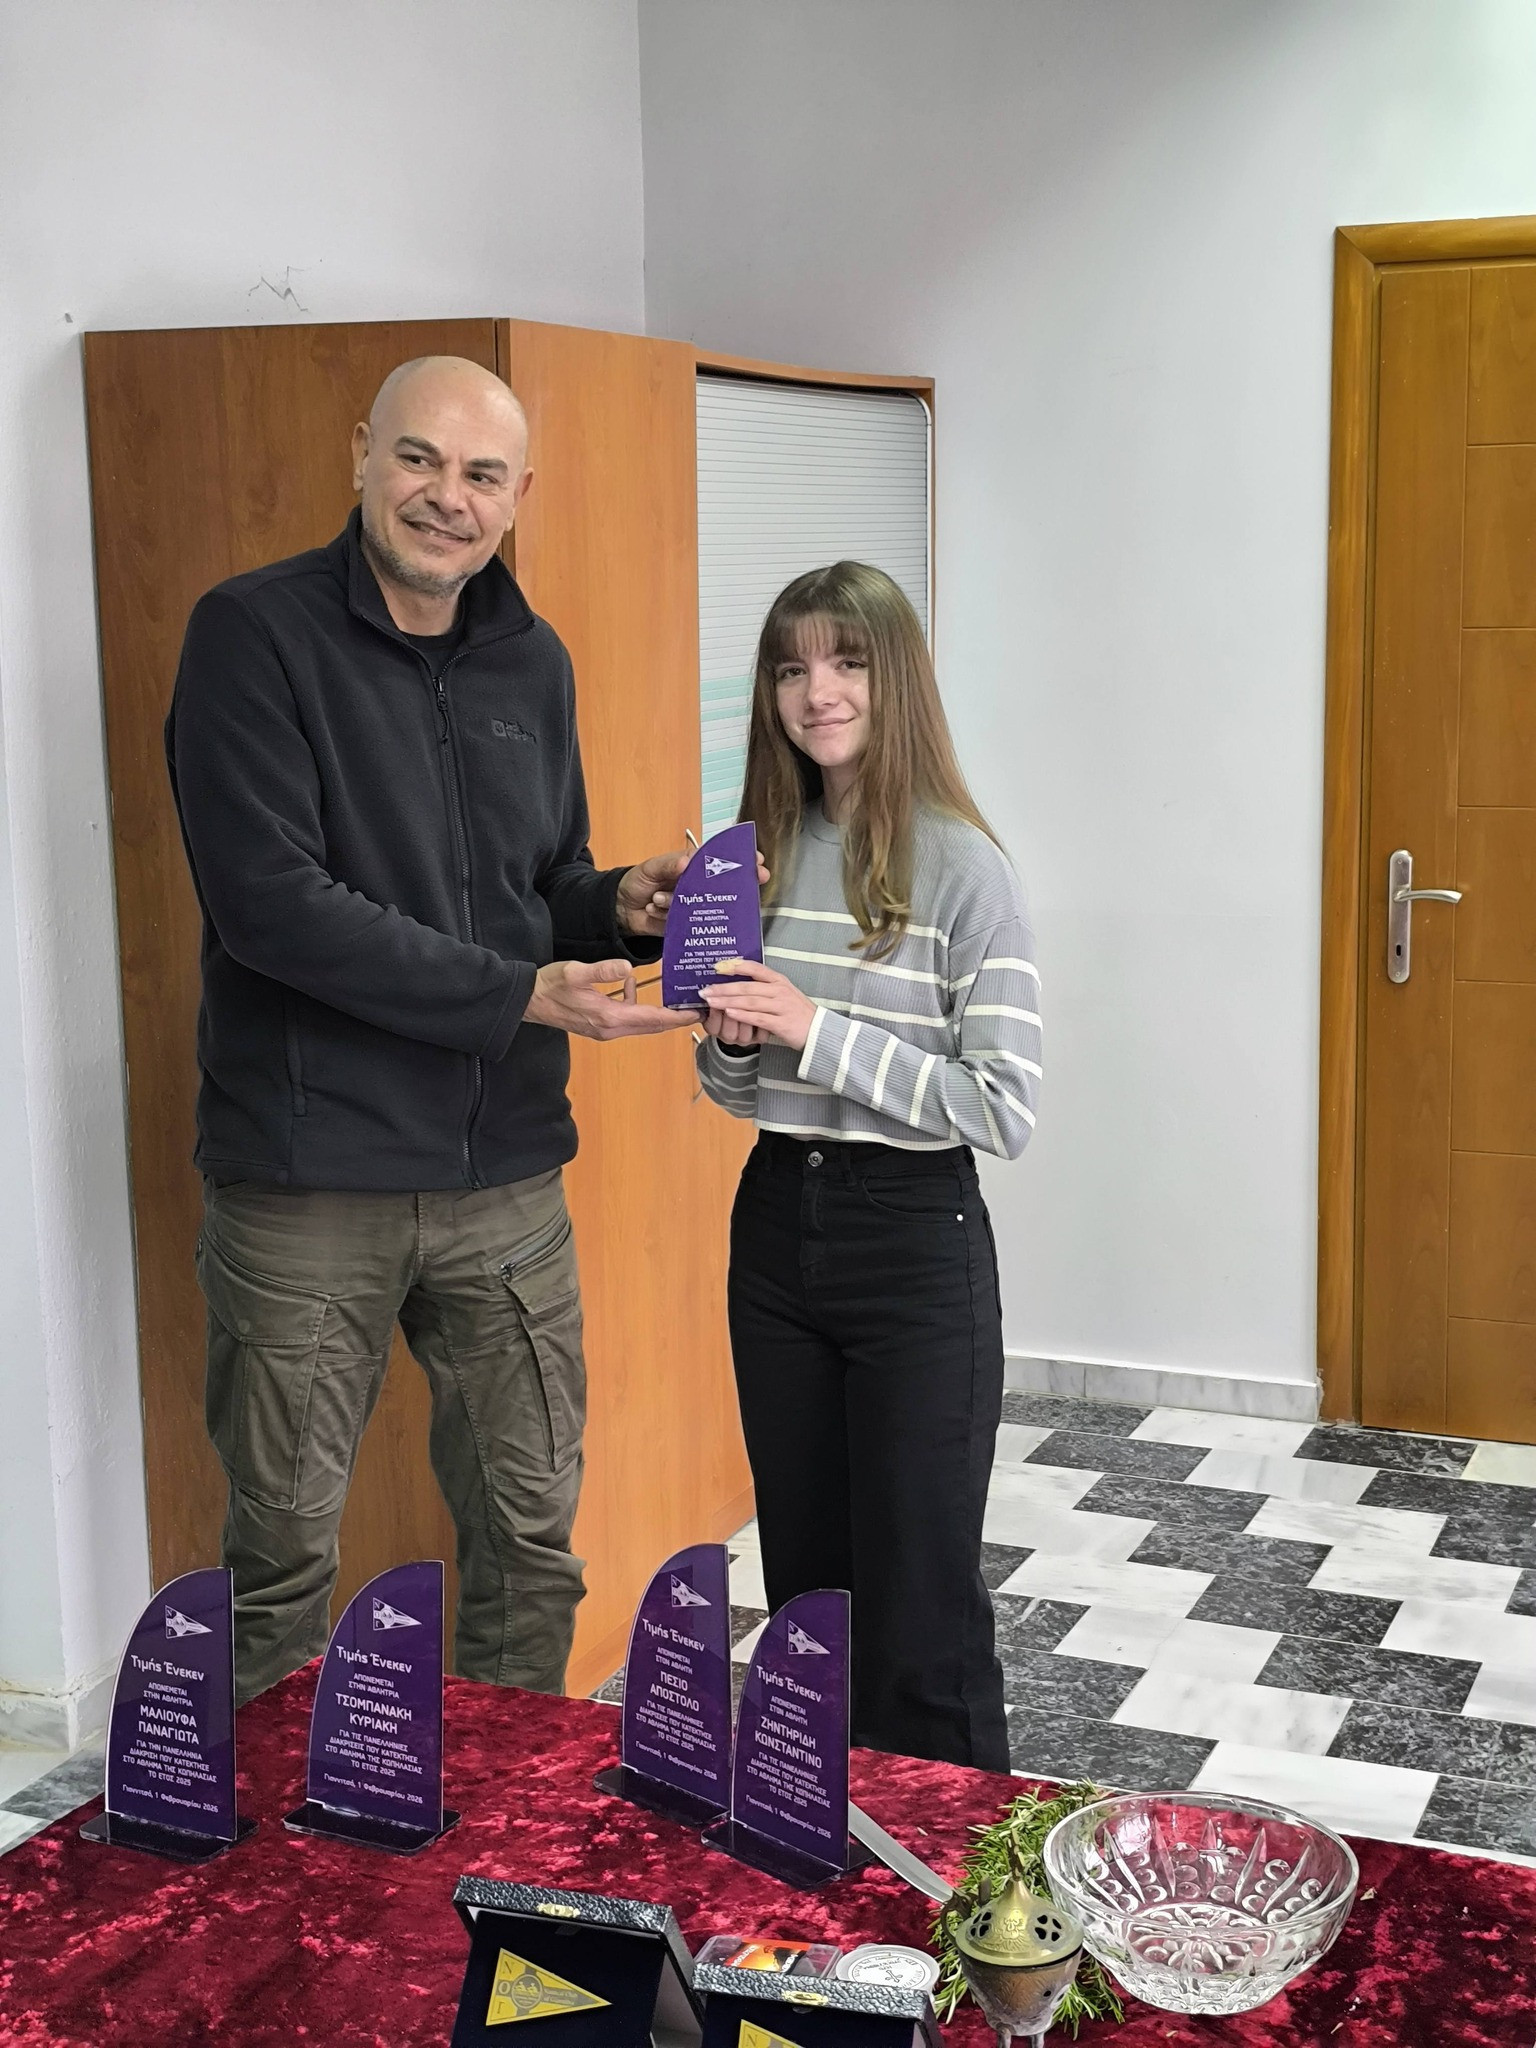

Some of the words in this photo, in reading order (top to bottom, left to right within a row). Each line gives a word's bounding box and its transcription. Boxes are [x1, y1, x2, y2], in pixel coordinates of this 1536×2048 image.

[678, 894, 703, 905] Τιμής
[705, 894, 737, 902] Ένεκεν
[692, 926, 728, 935] ΠΑΛΑΝΗ
[684, 937, 736, 947] ΑΙΚΑΤΕΡΙΝΗ
[642, 1618, 669, 1639] Τιμής
[670, 1628, 704, 1652] Ένεκεν
[131, 1655, 161, 1673] Τιμής
[164, 1661, 204, 1681] Ένεκεν
[336, 1645, 368, 1664] Τιμής
[370, 1653, 412, 1674] Ένεκεν
[348, 1681, 366, 1691] ΣΤΗΝ
[660, 1671, 688, 1692] ΠΕΣΙΟ
[756, 1665, 784, 1687] Τιμής
[785, 1677, 822, 1702] Ένεκεν
[143, 1690, 160, 1700] ΣΤΗΝ
[647, 1700, 656, 1709] ΓΙΑ
[650, 1683, 699, 1712] ΑΠΟΣΤΟΛΟ
[140, 1704, 197, 1728] ΜΑΛΙΟΥΦΑ
[335, 1693, 412, 1721] ΤΣΟΜΠΑΝΑΚΗ
[139, 1721, 199, 1745] ΠΑΝΑΓΙΩΤΑ
[350, 1713, 397, 1734] ΚΥΡΙΑΚΗ
[761, 1716, 816, 1749] ΖΗΝΤΗΡΙΔΗ
[340, 1729, 350, 1738] ΓΙΑ
[352, 1732, 362, 1741] ΤΙΣ
[136, 1740, 147, 1748] ΓΙΑ
[148, 1742, 160, 1751] ΤΗΝ
[163, 1744, 202, 1760] ΠΑΝΕΛΛΗΝΙΑ
[325, 1744, 338, 1754] ΣΤΟ
[340, 1748, 366, 1760] ΑΘΛΗΜΑ
[368, 1755, 380, 1764] ΤΗΣ
[681, 1740, 694, 1751] 2025
[755, 1730, 822, 1768] ΚΩΝΣΤΑΝΤΙΝΟ
[123, 1755, 135, 1764] ΣΤΟ
[137, 1758, 162, 1771] ΑΘΛΗΜΑ
[164, 1764, 176, 1773] ΤΗΣ
[759, 1751, 768, 1761] ΓΙΑ
[351, 1760, 360, 1768] ΤΟ
[362, 1762, 378, 1772] ΕΤΟΣ
[380, 1767, 396, 1777] 2025
[148, 1770, 157, 1778] ΤΟ
[158, 1772, 175, 1783] ΕΤΟΣ
[176, 1777, 192, 1787] 2025
[203, 1803, 219, 1813] 2026
[407, 1794, 423, 1804] 2026
